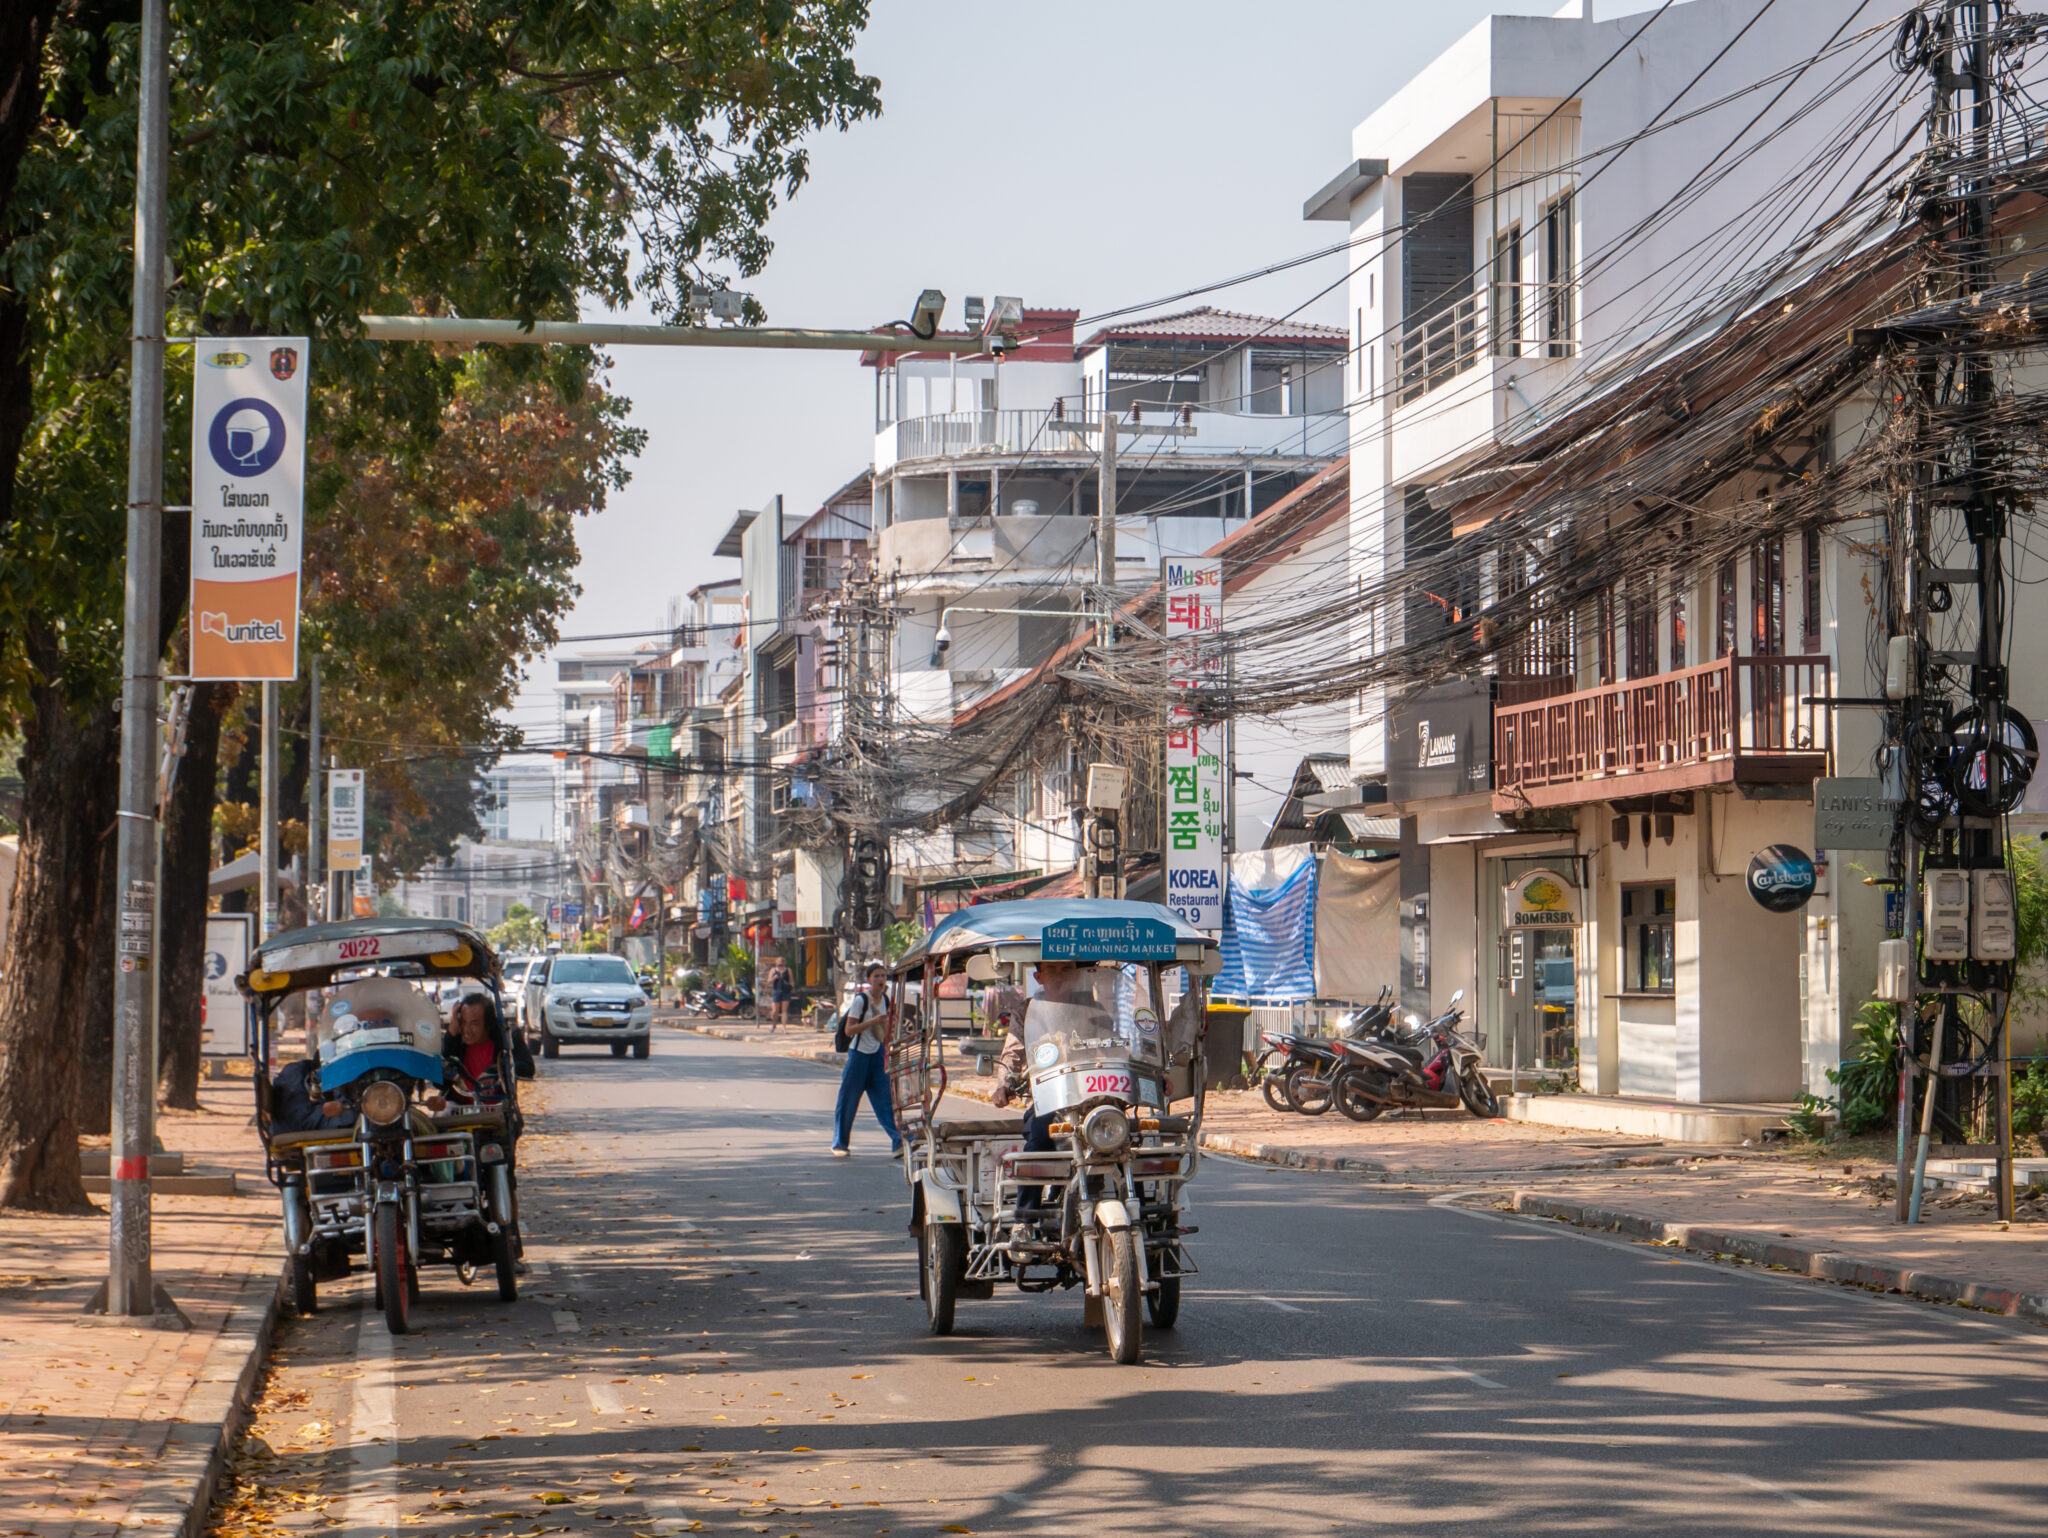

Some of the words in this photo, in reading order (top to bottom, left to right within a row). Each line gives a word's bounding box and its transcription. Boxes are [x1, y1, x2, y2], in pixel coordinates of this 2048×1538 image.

[1168, 565, 1219, 586] Music
[226, 620, 285, 642] unitel
[1169, 869, 1219, 889] KOREA
[1752, 868, 1813, 890] Carlsberg
[1169, 893, 1219, 906] Restaurant
[1514, 911, 1576, 925] SOMERSBY
[338, 938, 381, 960] 2022
[1078, 944, 1129, 954] MORNING
[1131, 943, 1177, 954] MARKET
[1085, 1074, 1132, 1094] 2022
